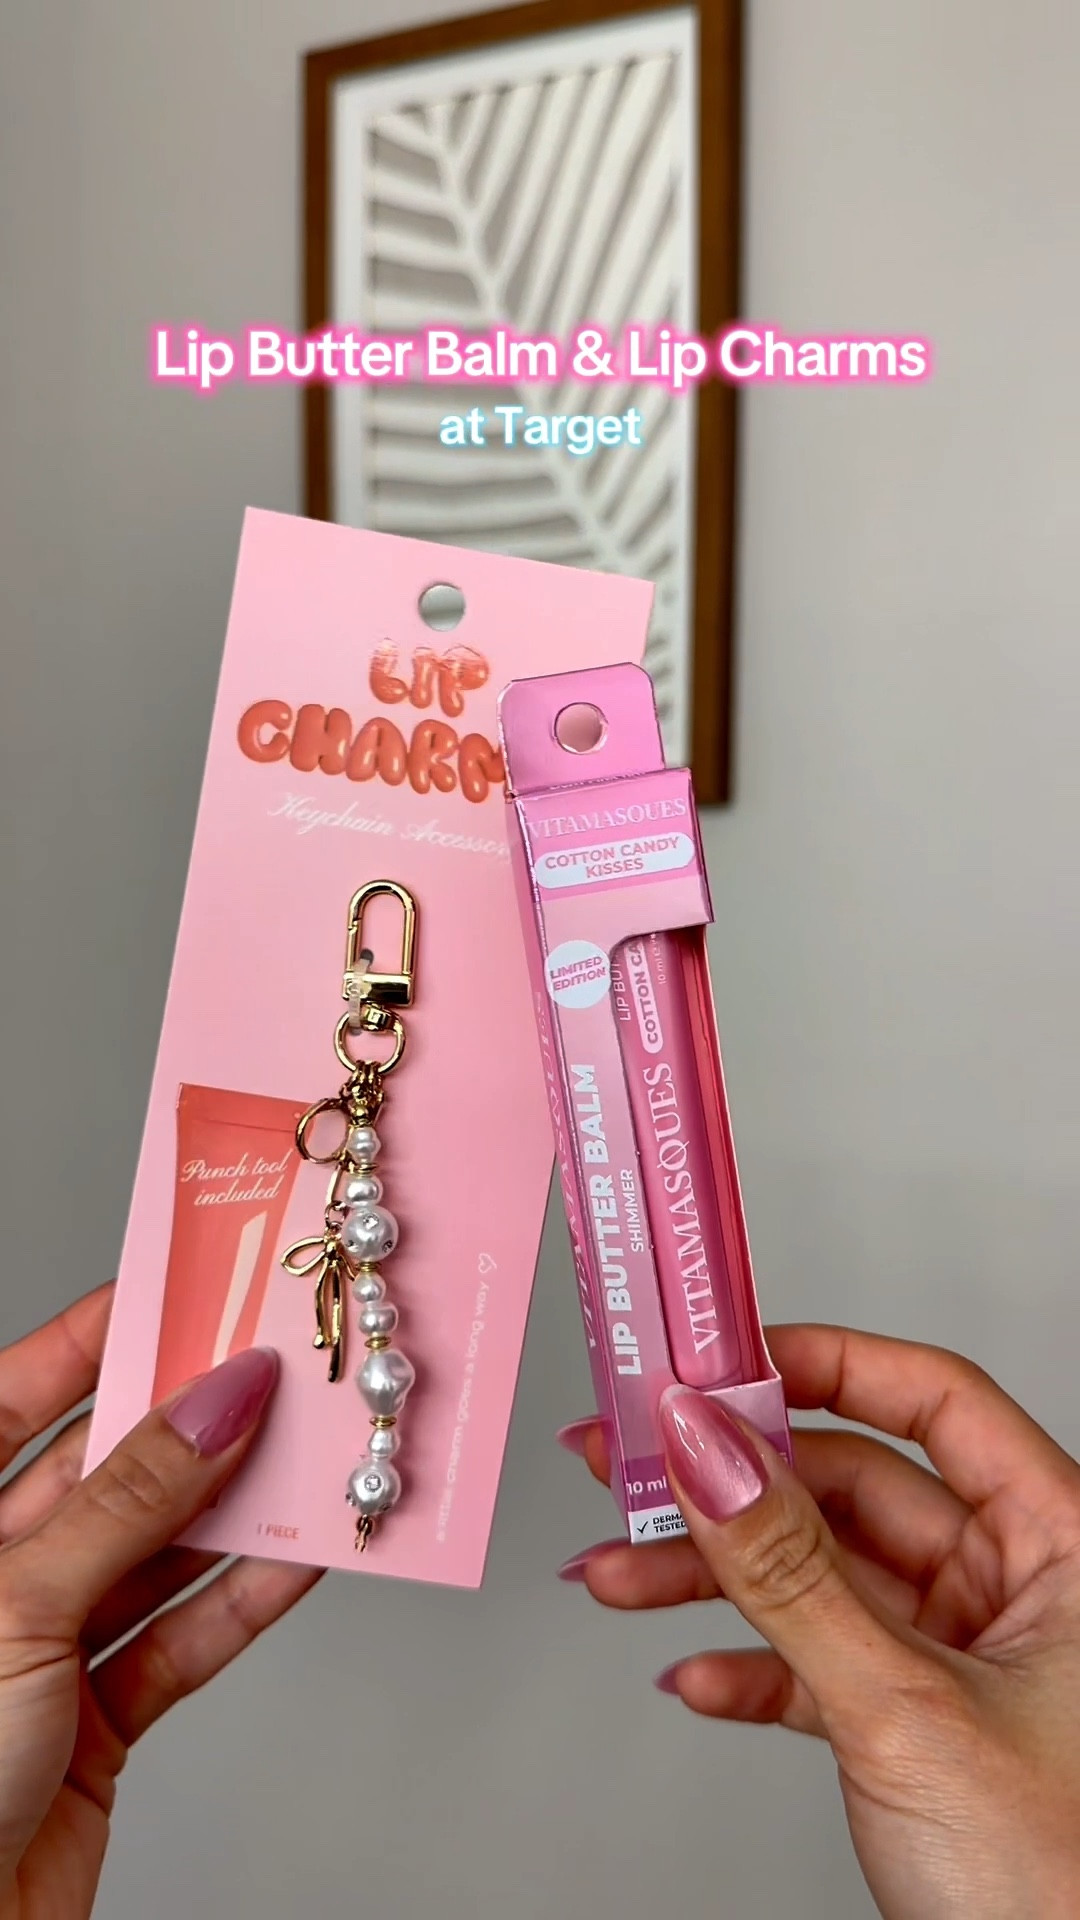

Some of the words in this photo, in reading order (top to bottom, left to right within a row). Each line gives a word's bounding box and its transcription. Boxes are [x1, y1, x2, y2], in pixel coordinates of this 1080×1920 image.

[369, 637, 489, 717] LIP
[267, 793, 394, 834] Keychain
[527, 800, 686, 840] VITAMASQUES
[545, 847, 615, 869] COTTON
[621, 837, 679, 857] CANDY
[586, 858, 644, 878] KISSES
[551, 956, 602, 979] LIMITED
[553, 967, 606, 991] EDITION
[617, 997, 631, 1021] LIP
[634, 971, 659, 1044] COTTON
[570, 1064, 609, 1163] BALM
[180, 1152, 249, 1182] Punch
[252, 1148, 293, 1176] tool
[194, 1175, 284, 1206] included
[643, 1062, 721, 1354] VITAMASQUES
[617, 1168, 644, 1252] SHIMMER
[590, 1174, 632, 1309] BUTTER
[475, 1281, 490, 1316] way
[465, 1319, 484, 1358] long
[612, 1320, 643, 1375] LIP
[466, 1362, 475, 1374] a
[457, 1377, 472, 1422] goes
[626, 1481, 643, 1496] 10
[647, 1475, 667, 1492] ml
[266, 1523, 300, 1540] PIECE
[654, 1520, 686, 1533] TESTED
